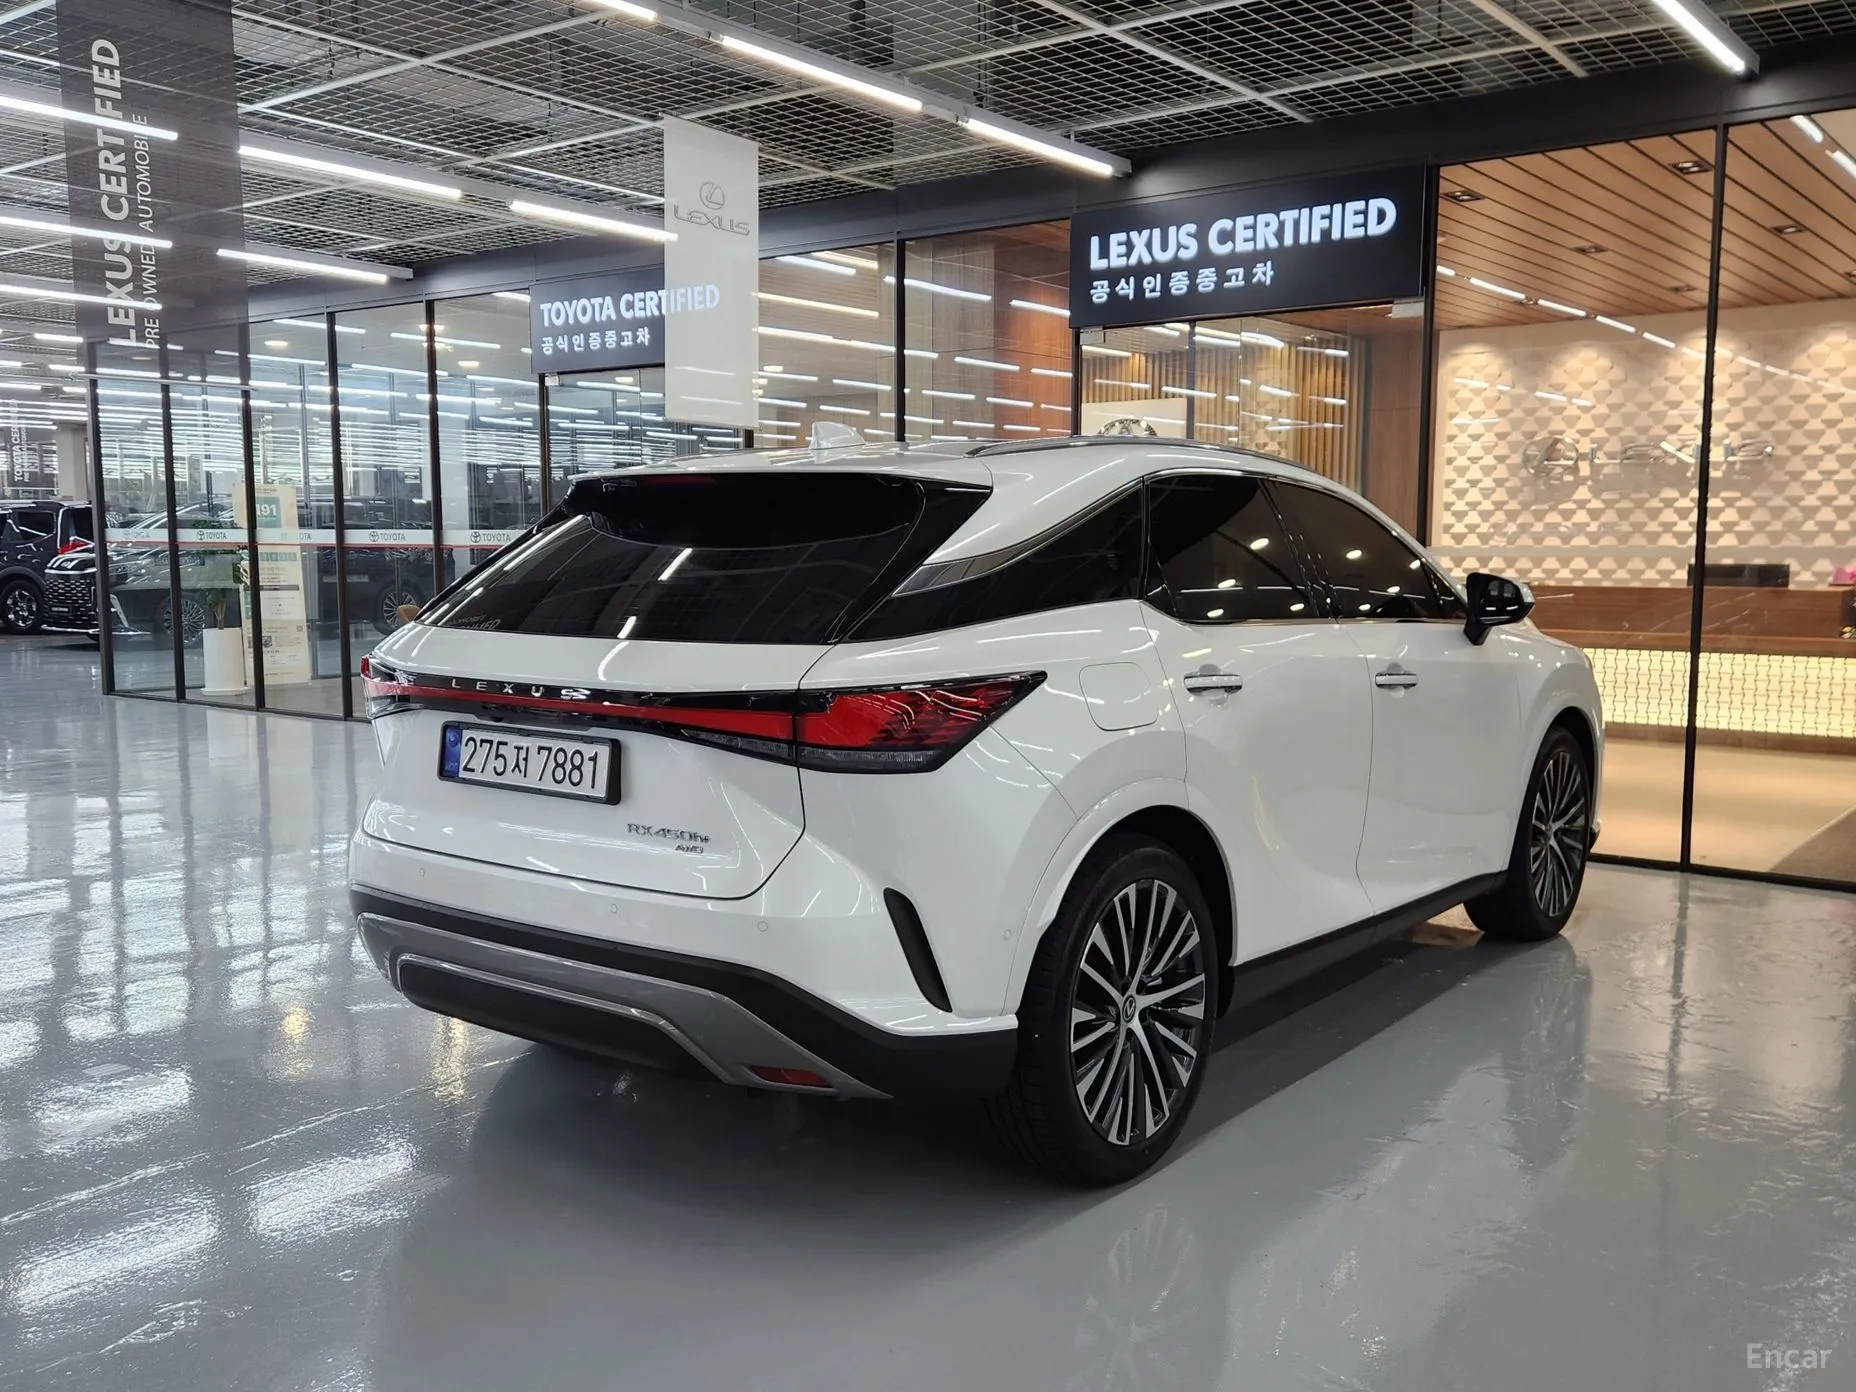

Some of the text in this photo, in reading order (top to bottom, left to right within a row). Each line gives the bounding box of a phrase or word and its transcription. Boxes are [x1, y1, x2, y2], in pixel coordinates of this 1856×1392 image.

[91, 39, 129, 221] CERTFIED
[132, 113, 154, 233] AUTOMOBIE
[674, 204, 750, 236] LEXUS
[1090, 198, 1397, 270] LEXUS CERTIFIED
[540, 285, 720, 327] TOYOTA CERTIFIED
[380, 533, 406, 541] TOYOTA
[482, 533, 511, 542] TOYOTA
